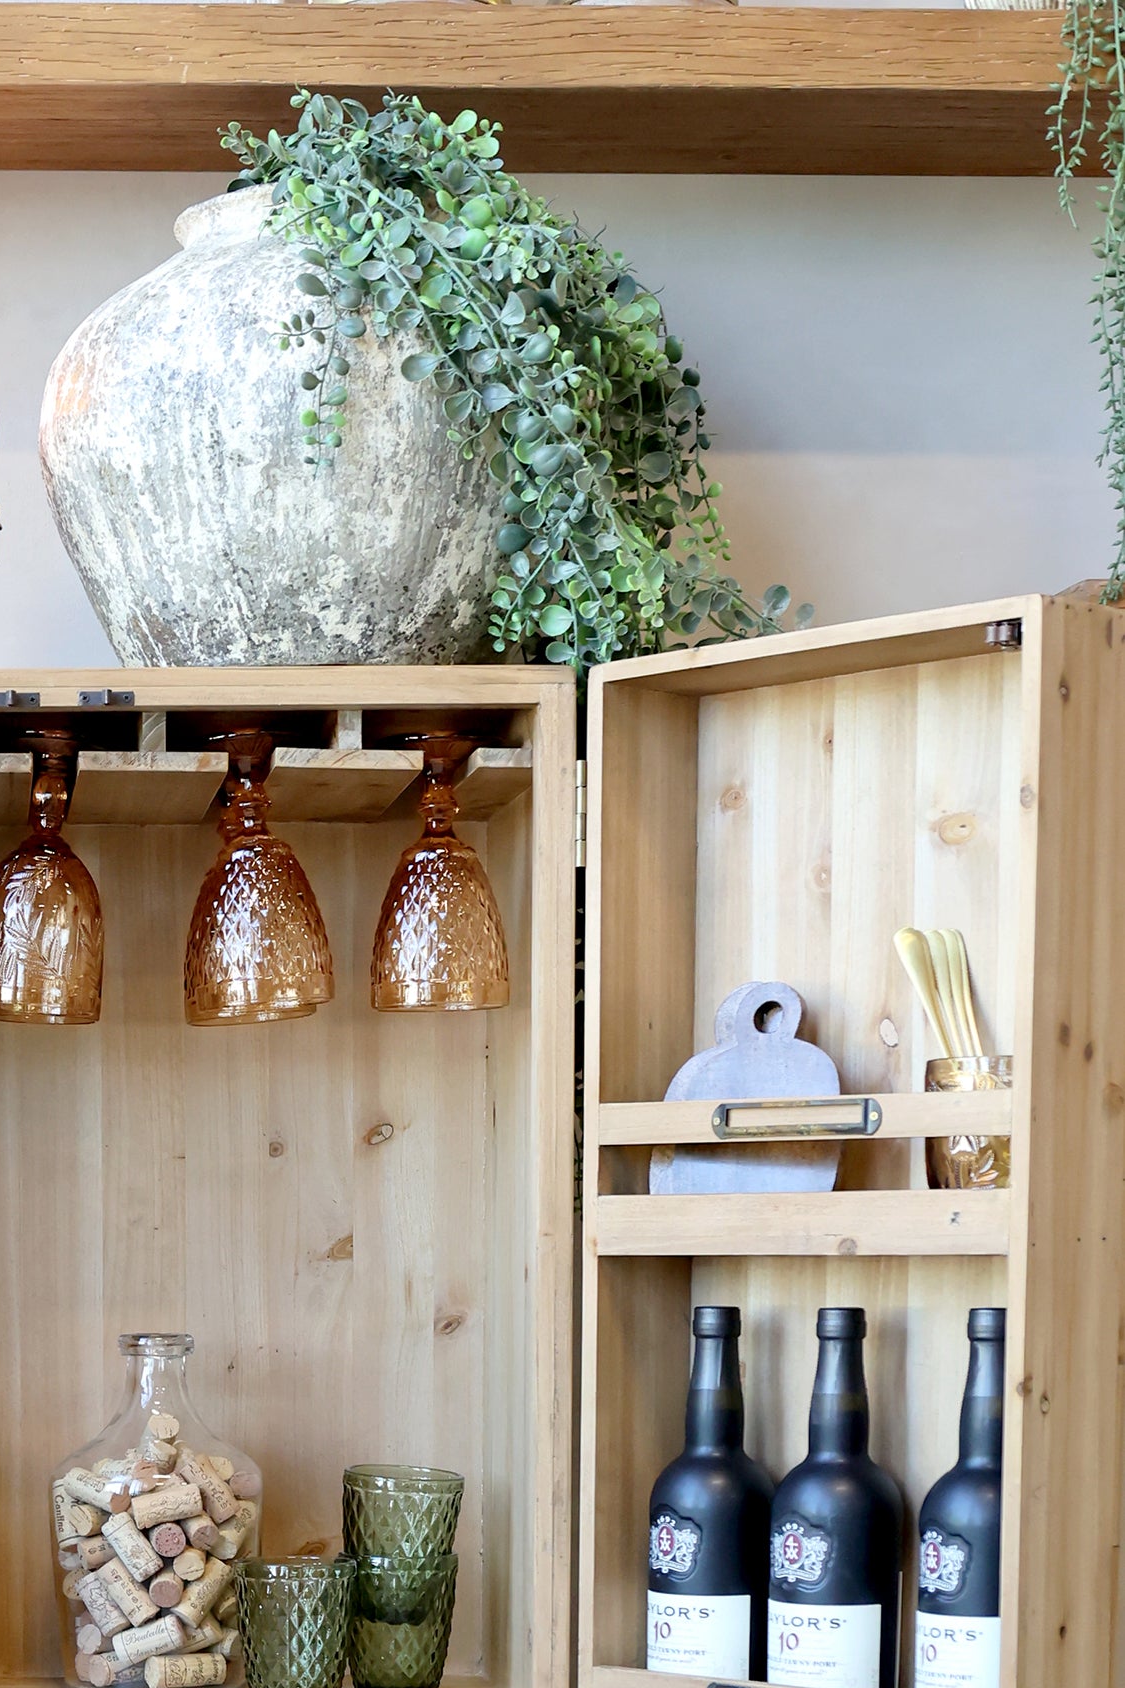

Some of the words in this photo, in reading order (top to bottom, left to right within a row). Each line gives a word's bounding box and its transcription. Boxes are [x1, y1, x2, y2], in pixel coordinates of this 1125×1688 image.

[656, 1515, 676, 1527] 1692
[781, 1522, 805, 1535] 1692
[653, 1620, 672, 1644] 10
[778, 1631, 800, 1656] 10
[920, 1642, 938, 1667] 10
